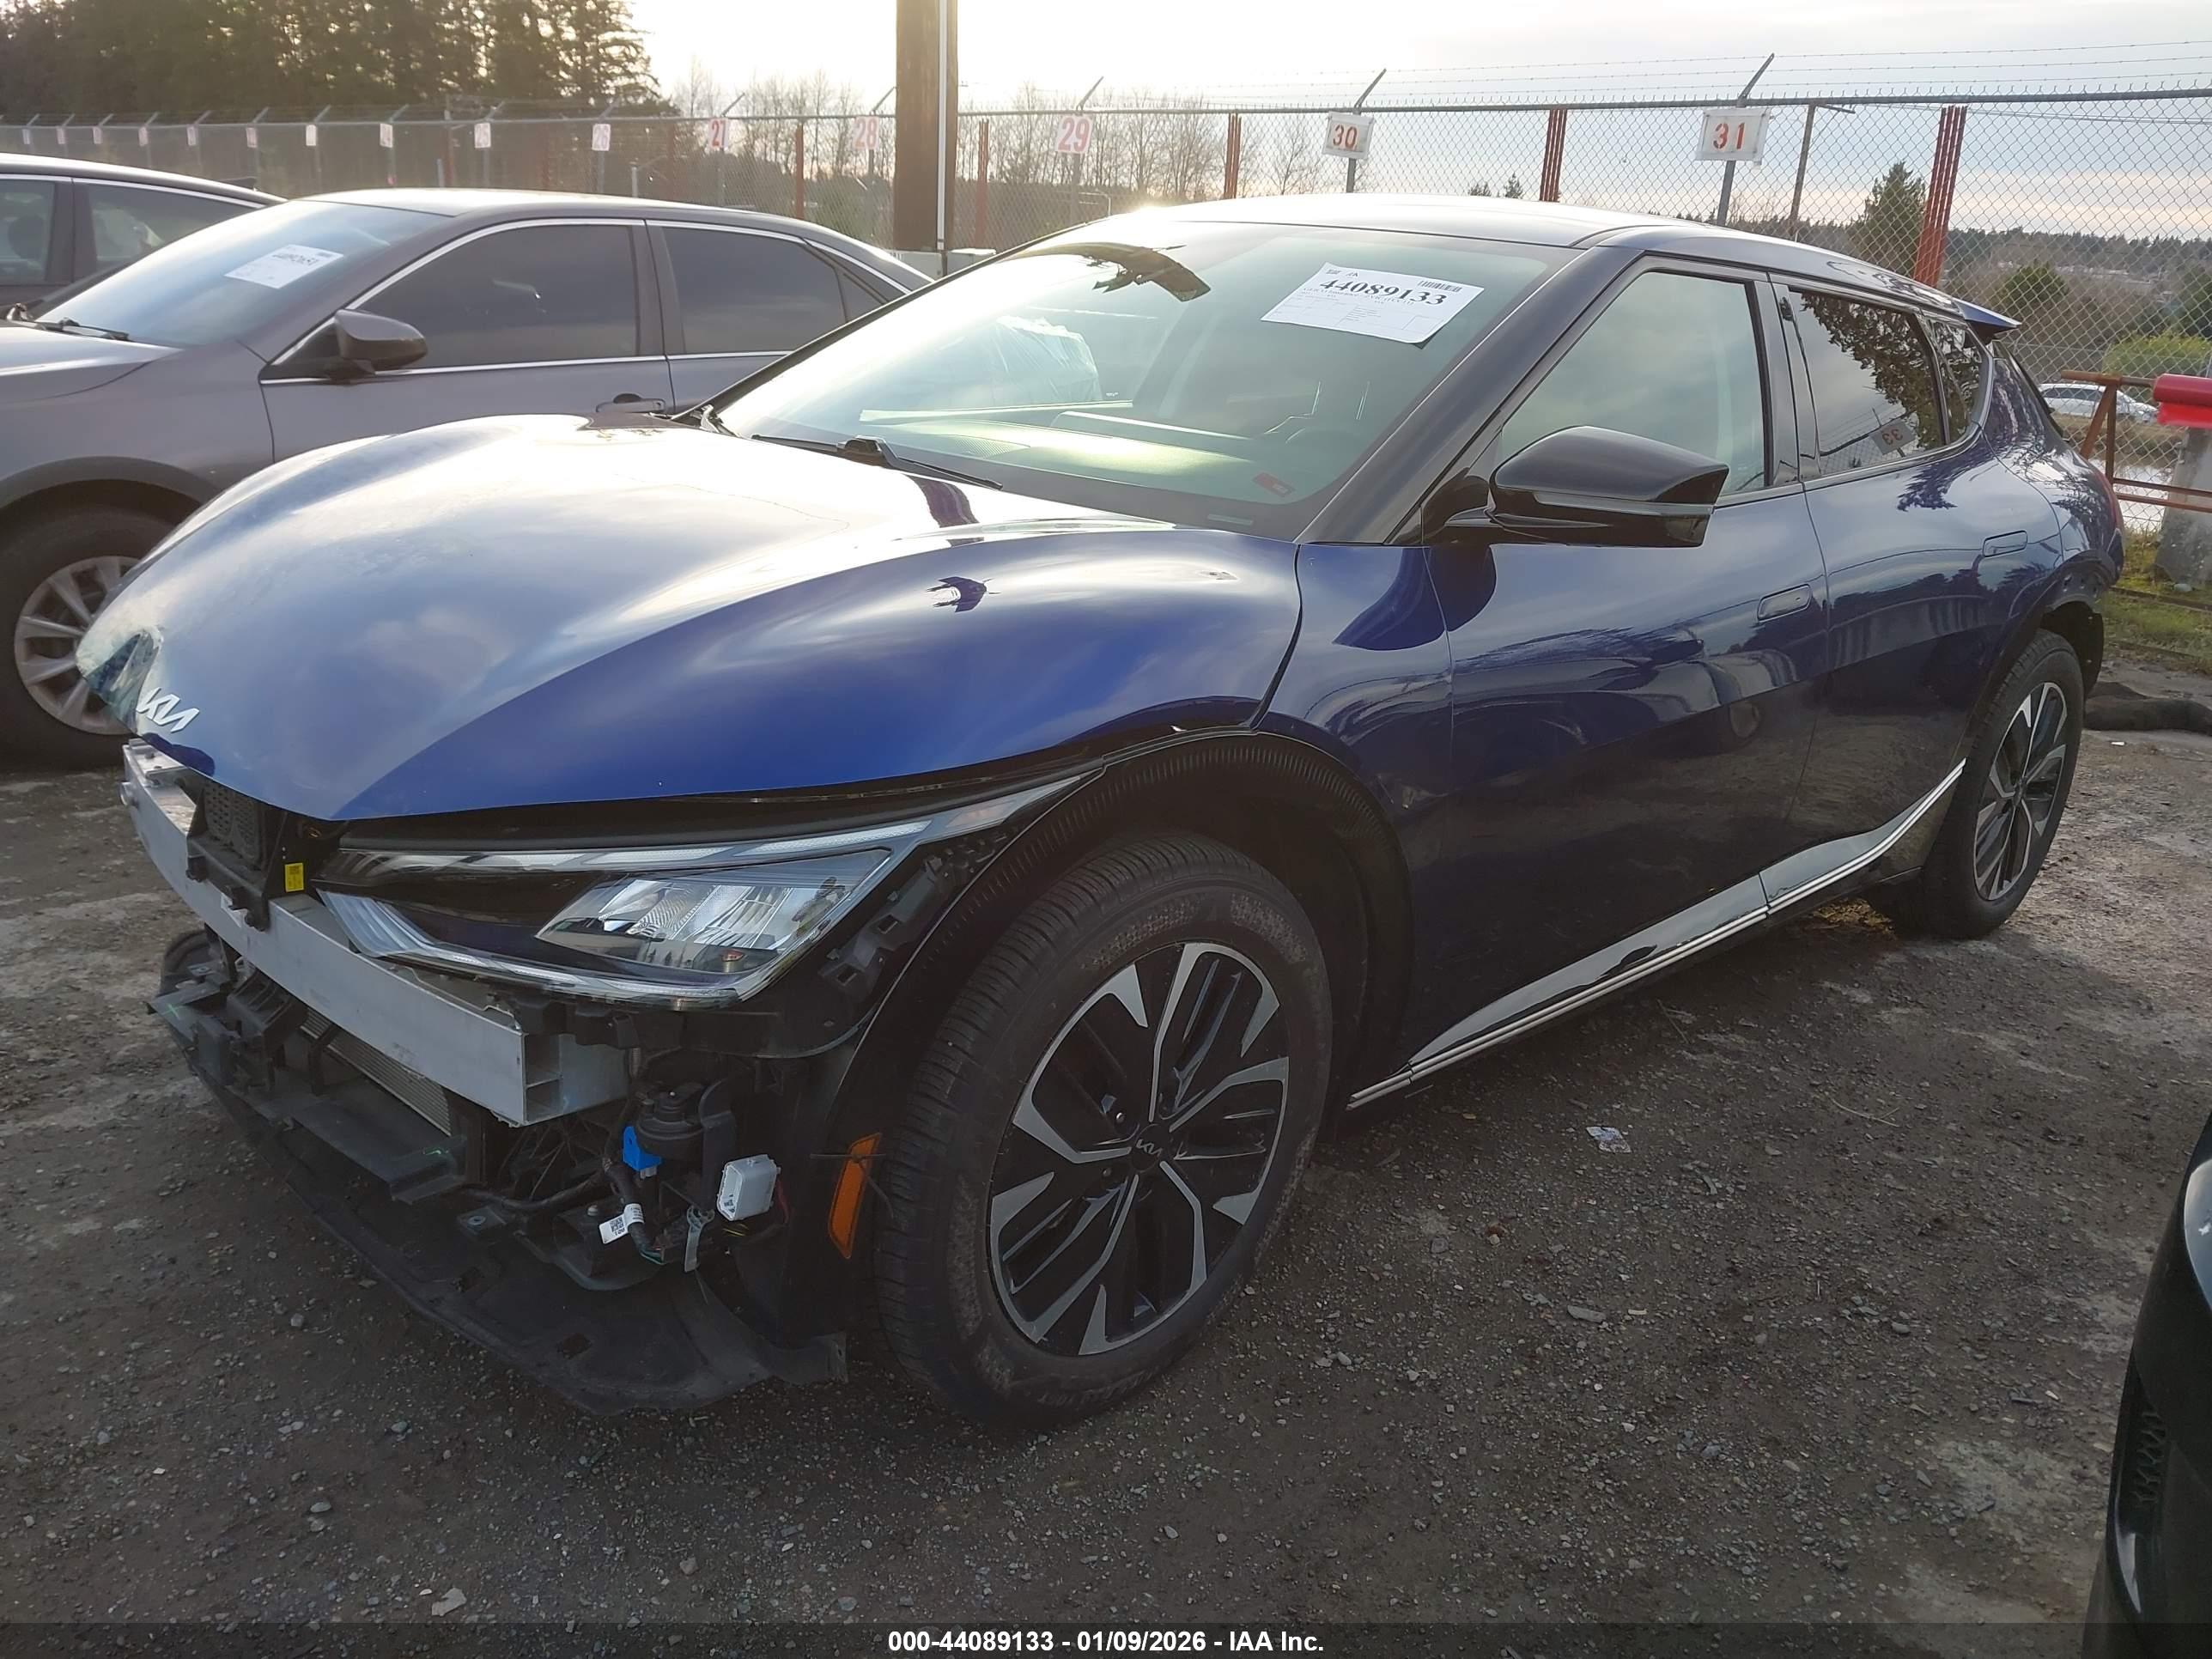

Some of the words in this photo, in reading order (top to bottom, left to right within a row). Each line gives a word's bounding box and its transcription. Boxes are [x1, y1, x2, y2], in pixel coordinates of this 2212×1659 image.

[711, 118, 728, 148] 27
[854, 117, 878, 149] 28
[1058, 117, 1090, 152] 29
[1333, 124, 1357, 149] 30
[1713, 122, 1745, 150] 31
[1320, 279, 1448, 305] 44089133
